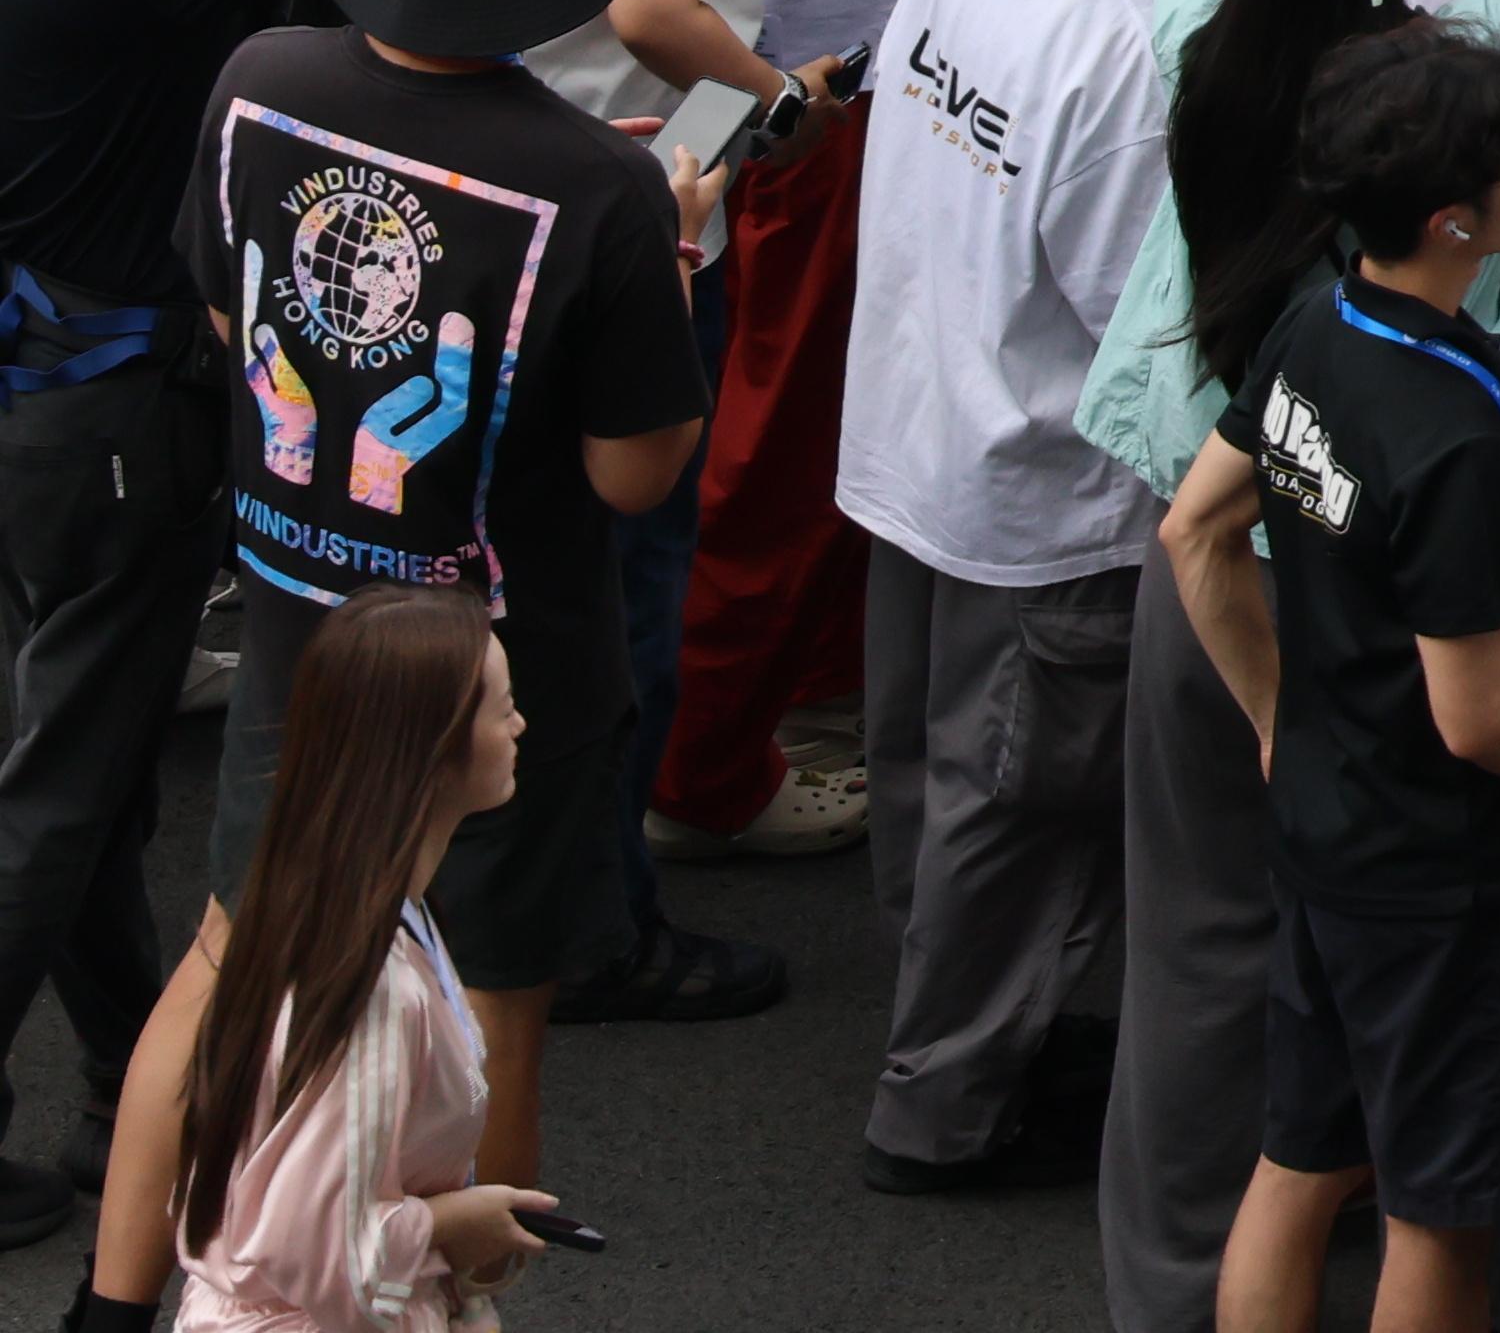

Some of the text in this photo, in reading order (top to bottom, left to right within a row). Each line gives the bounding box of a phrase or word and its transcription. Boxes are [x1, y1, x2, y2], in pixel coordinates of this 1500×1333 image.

[280, 166, 444, 264] VINDUSTRIES
[270, 275, 431, 371] HONG KONG
